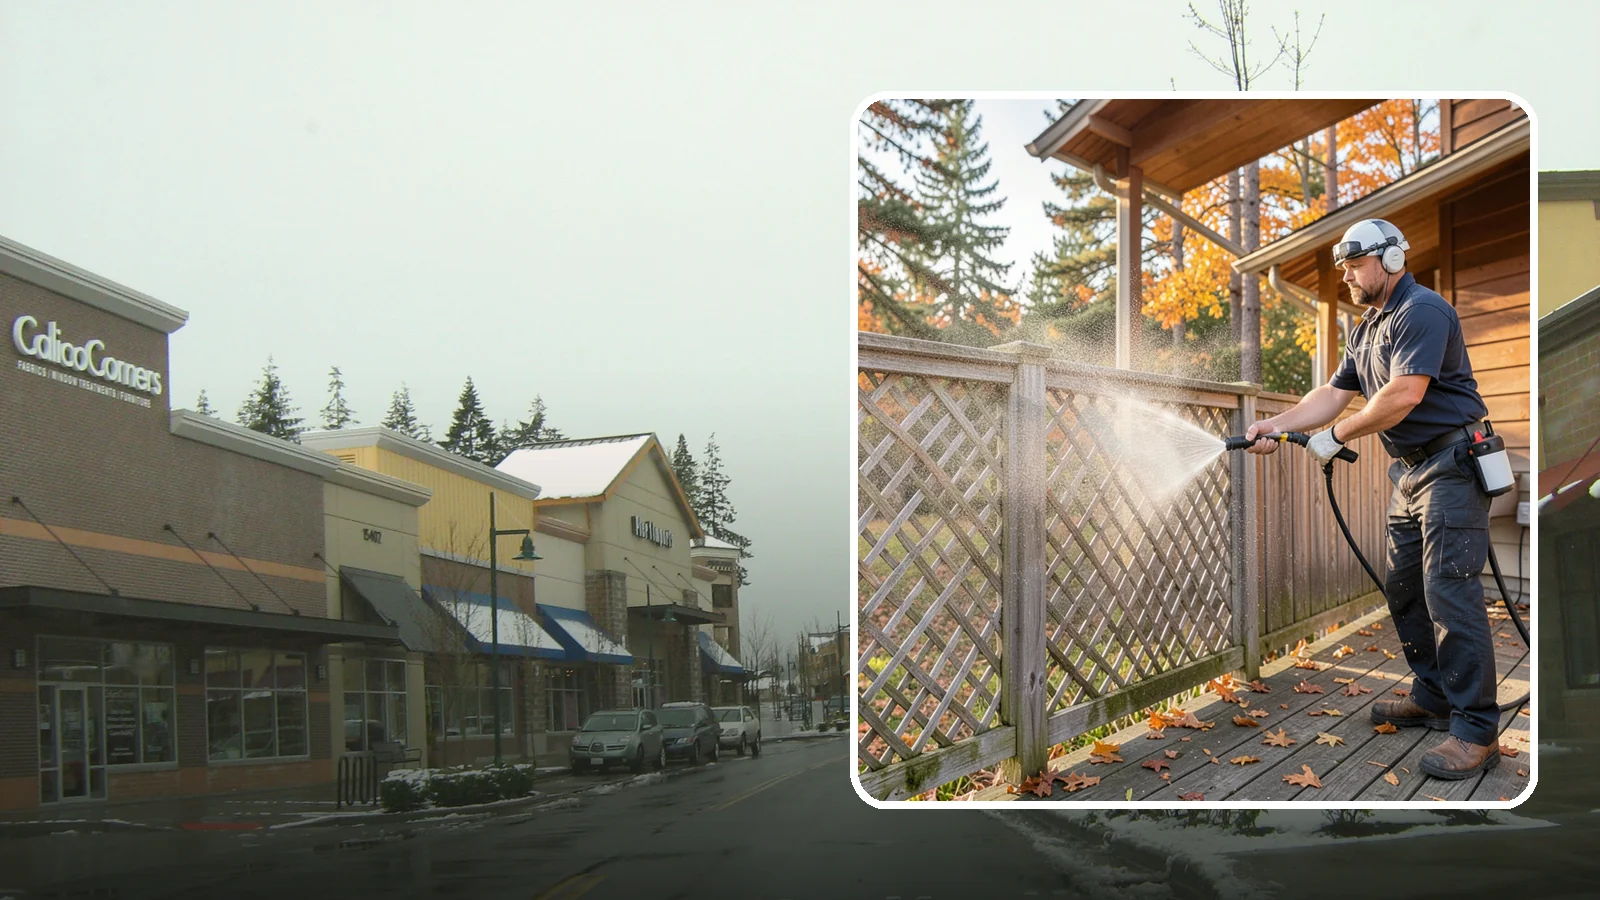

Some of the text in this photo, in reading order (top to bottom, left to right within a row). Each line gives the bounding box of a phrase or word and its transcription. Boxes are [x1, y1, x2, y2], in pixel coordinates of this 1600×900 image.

[16, 359, 151, 409] FABRICS WINDOW TREATMENTS FURNITURE
